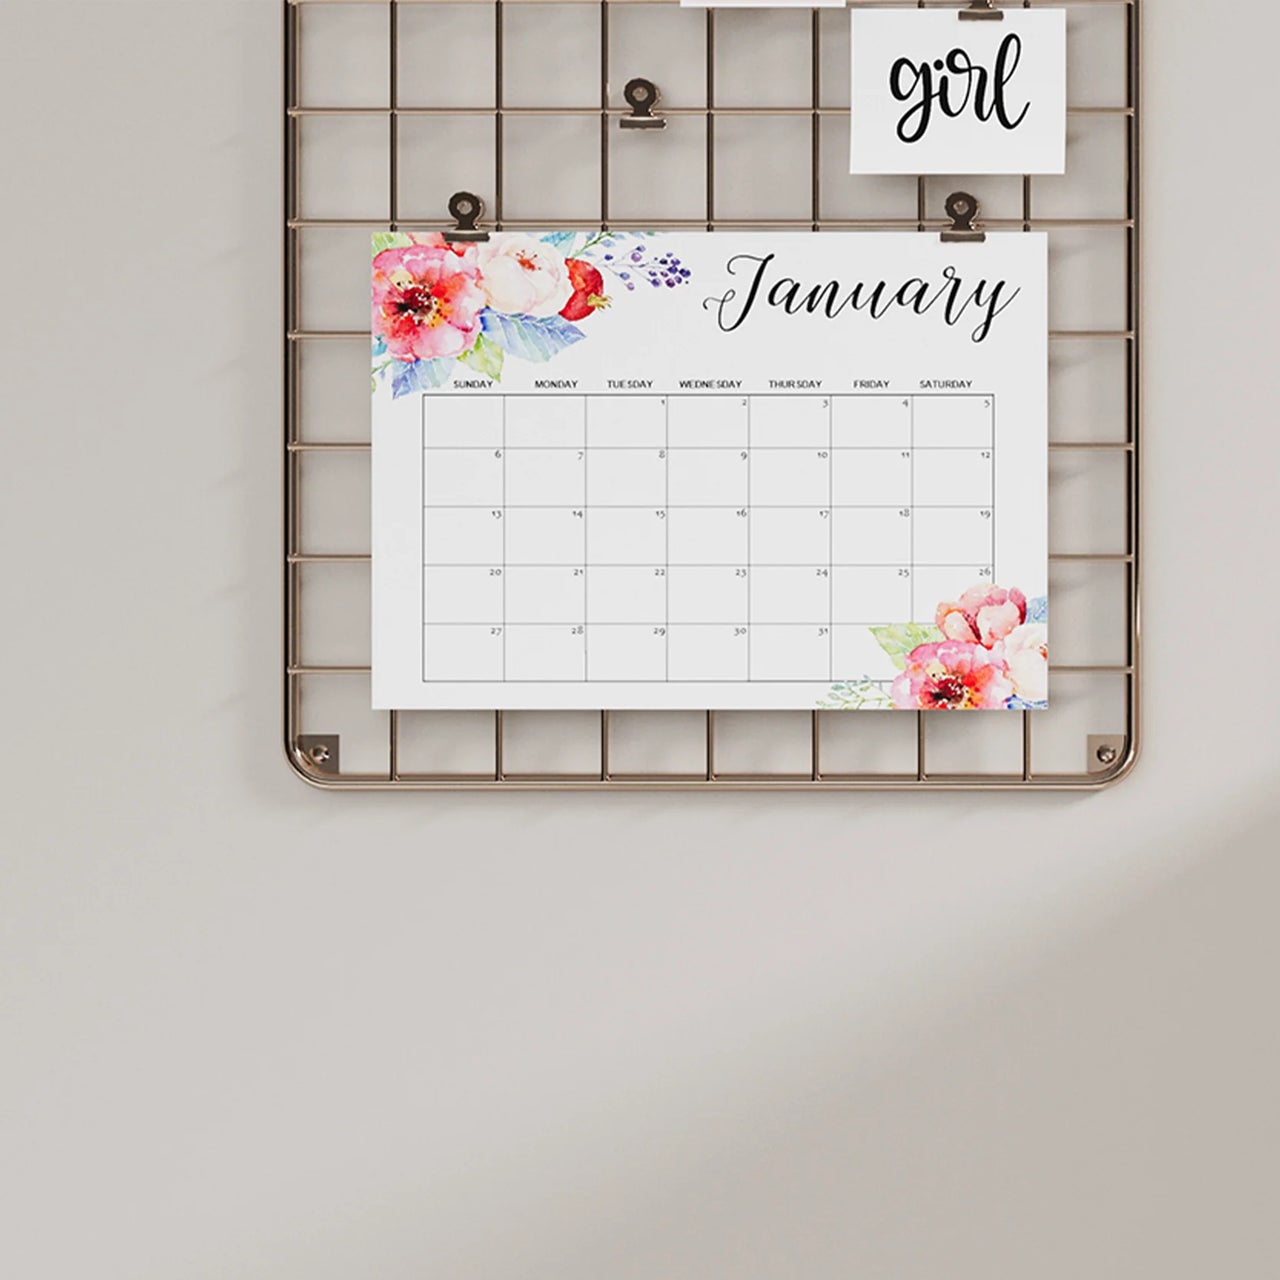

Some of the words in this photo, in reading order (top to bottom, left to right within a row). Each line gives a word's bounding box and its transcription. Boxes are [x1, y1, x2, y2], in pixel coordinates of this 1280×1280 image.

[889, 32, 1031, 144] girl
[702, 253, 1021, 344] January
[453, 379, 494, 389] SUNDAY
[534, 379, 579, 389] MONDAY
[606, 379, 654, 389] TUESDAY
[678, 379, 743, 389] WEDNESDAY
[768, 379, 823, 389] THURSDAY
[853, 379, 890, 389] FRIDAY
[919, 379, 973, 389] SATURDAY
[817, 451, 829, 460] 10
[900, 451, 910, 459] 11
[980, 451, 991, 459] 12
[491, 509, 503, 520] 13
[572, 510, 584, 519] 14
[655, 510, 666, 520] 15
[736, 509, 748, 518] 16
[819, 509, 830, 520] 17
[898, 509, 910, 518] 18
[979, 510, 992, 520] 19
[489, 568, 503, 577] 20
[573, 568, 584, 577] 21
[654, 568, 666, 577] 22
[735, 568, 747, 579] 23
[815, 568, 829, 578] 24
[897, 568, 910, 578] 25
[978, 567, 992, 577] 26
[490, 627, 503, 637] 27
[571, 626, 584, 635] 28
[653, 627, 666, 637] 29
[733, 627, 747, 637] 30
[818, 627, 829, 637] 31
